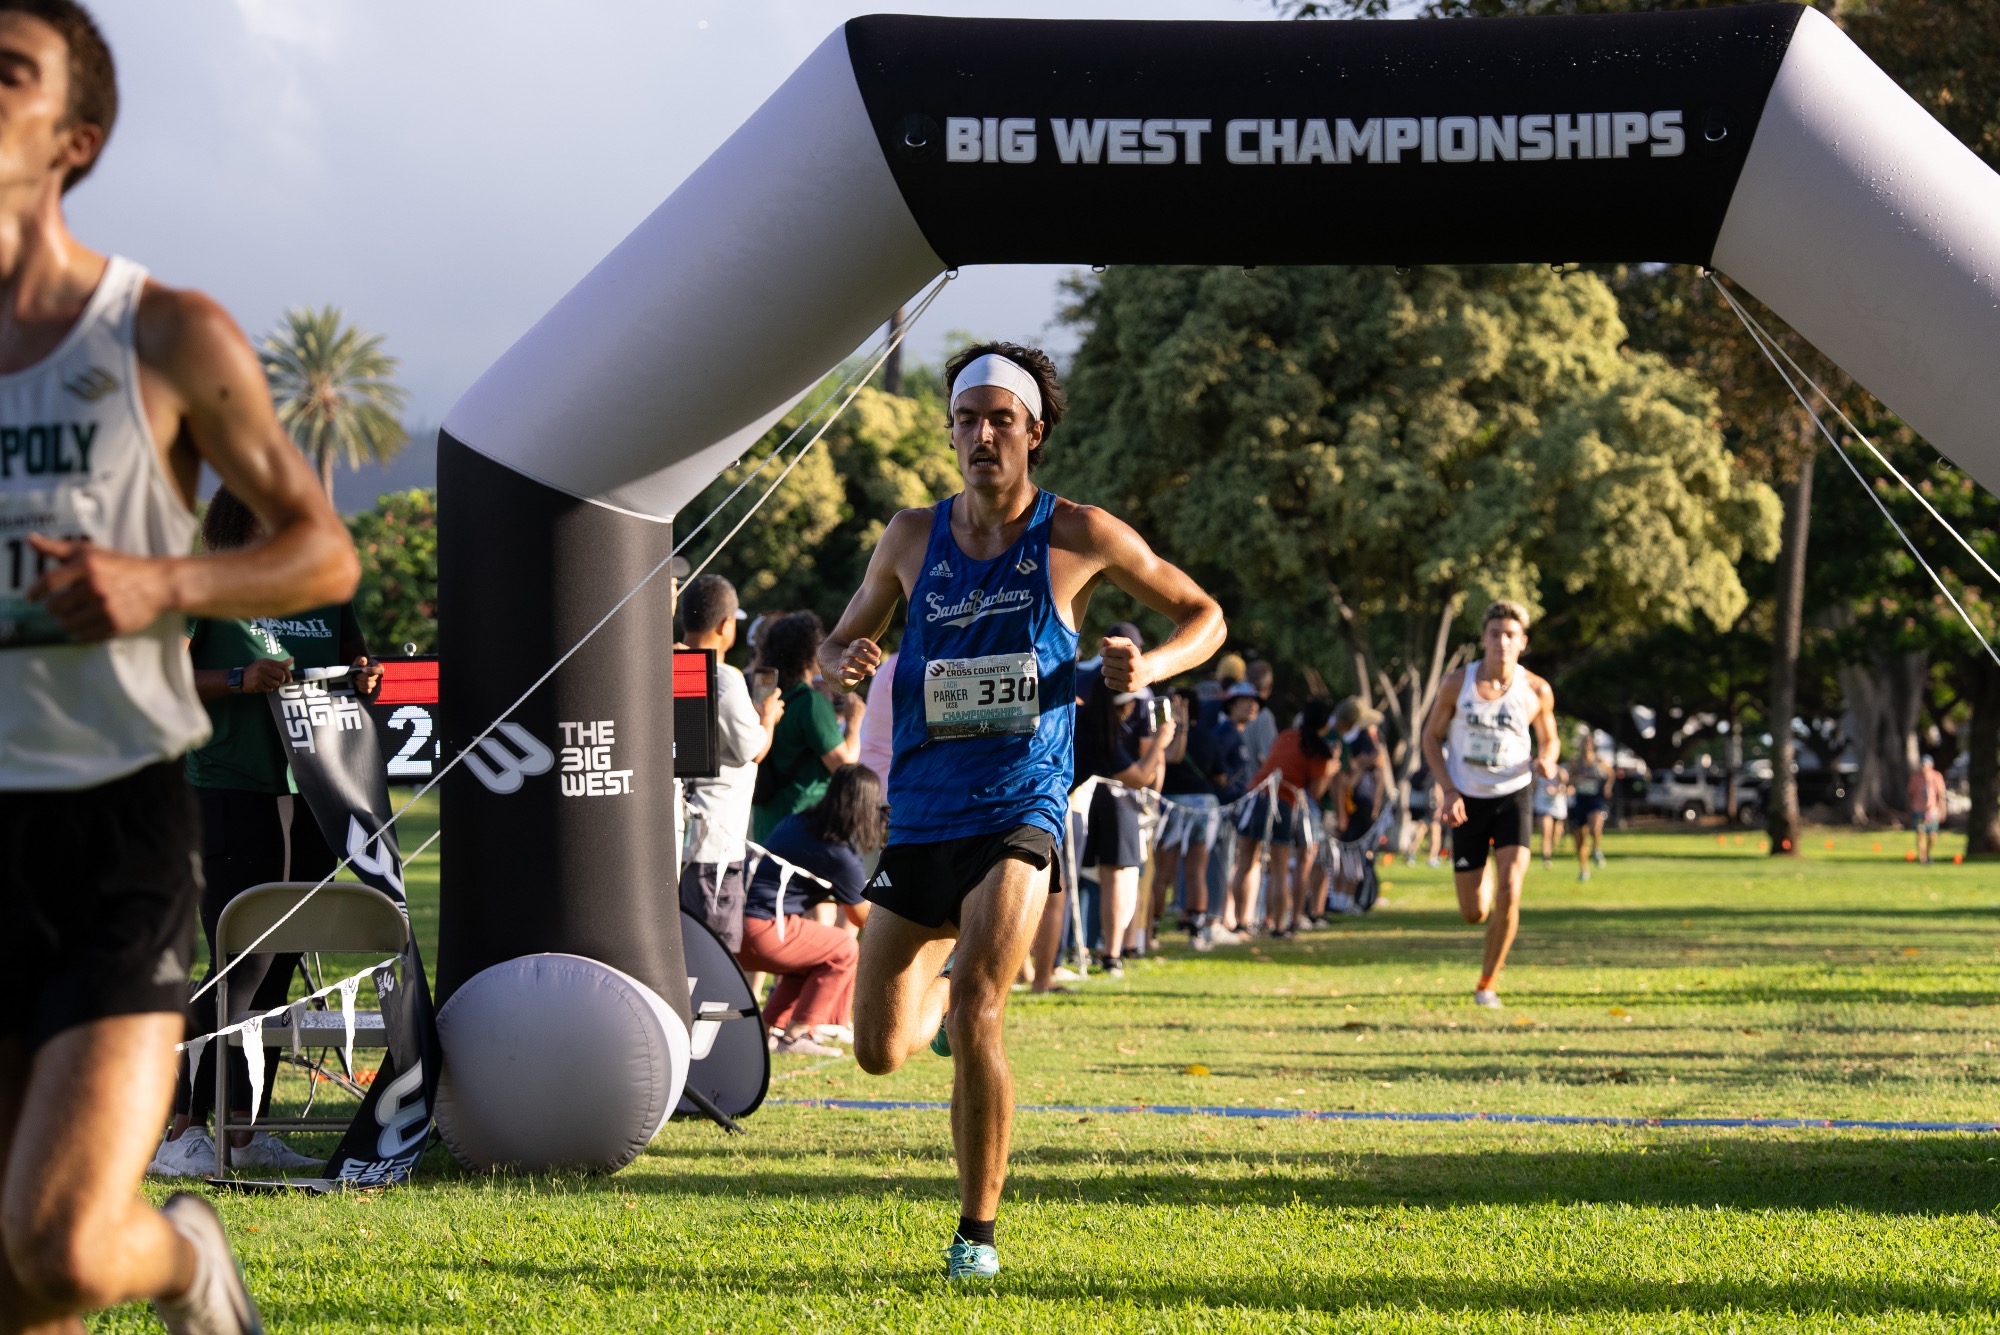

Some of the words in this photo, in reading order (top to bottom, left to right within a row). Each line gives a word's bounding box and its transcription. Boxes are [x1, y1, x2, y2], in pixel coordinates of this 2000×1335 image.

[946, 117, 1037, 164] BIG
[1051, 117, 1211, 165] WEST
[1225, 110, 1686, 165] CHAMPIONSHIPS
[1, 423, 97, 477] POLY
[929, 570, 953, 578] adidas
[926, 592, 972, 622] Santa
[968, 587, 1031, 615] Barbara
[287, 629, 305, 637] AND
[946, 661, 965, 670] THE
[946, 668, 972, 678] CROSS
[973, 665, 1011, 675] COUNTRY
[933, 689, 968, 703] PARKER
[978, 677, 1036, 705] 330
[942, 706, 1023, 721] CHAMPIONSHIPS
[558, 720, 615, 746] THE
[560, 745, 612, 772] BIG
[561, 769, 634, 797] WEST
